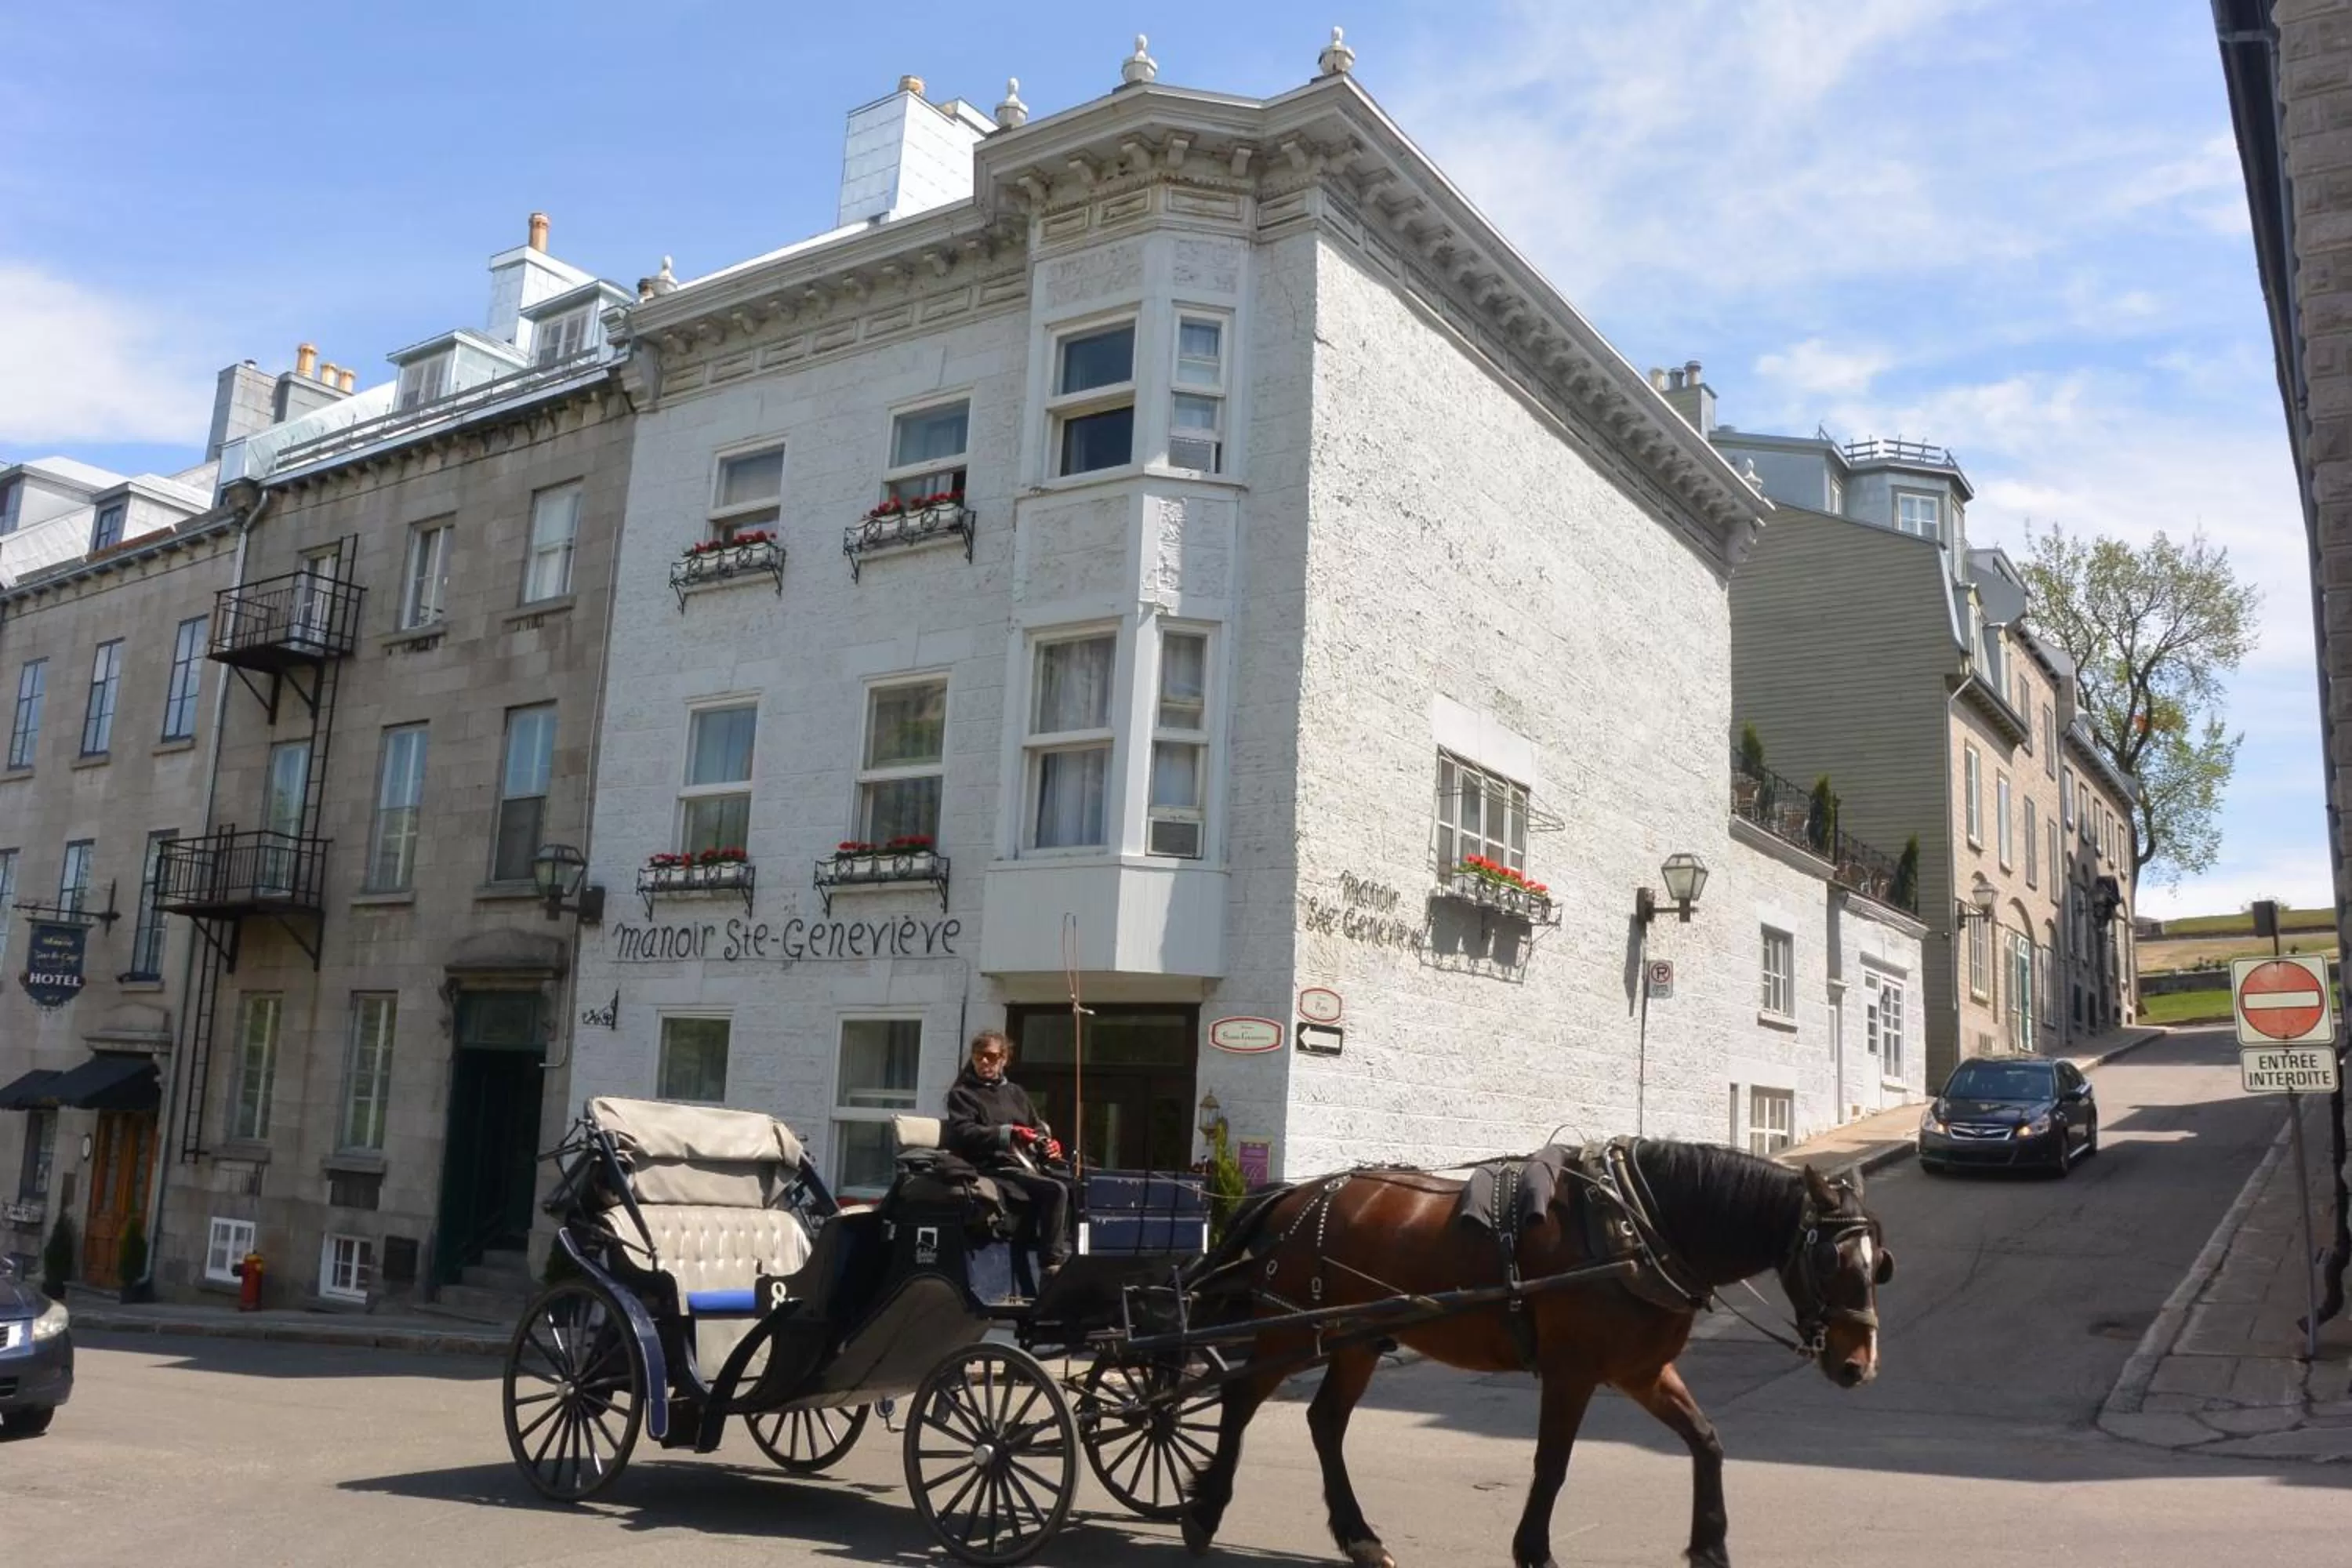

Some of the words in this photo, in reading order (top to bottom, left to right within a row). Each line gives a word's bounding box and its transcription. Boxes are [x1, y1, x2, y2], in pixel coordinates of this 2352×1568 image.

[29, 972, 82, 987] HOTEL
[2259, 1053, 2318, 1069] ENTRÉE
[2249, 1070, 2332, 1086] INTERDITE
